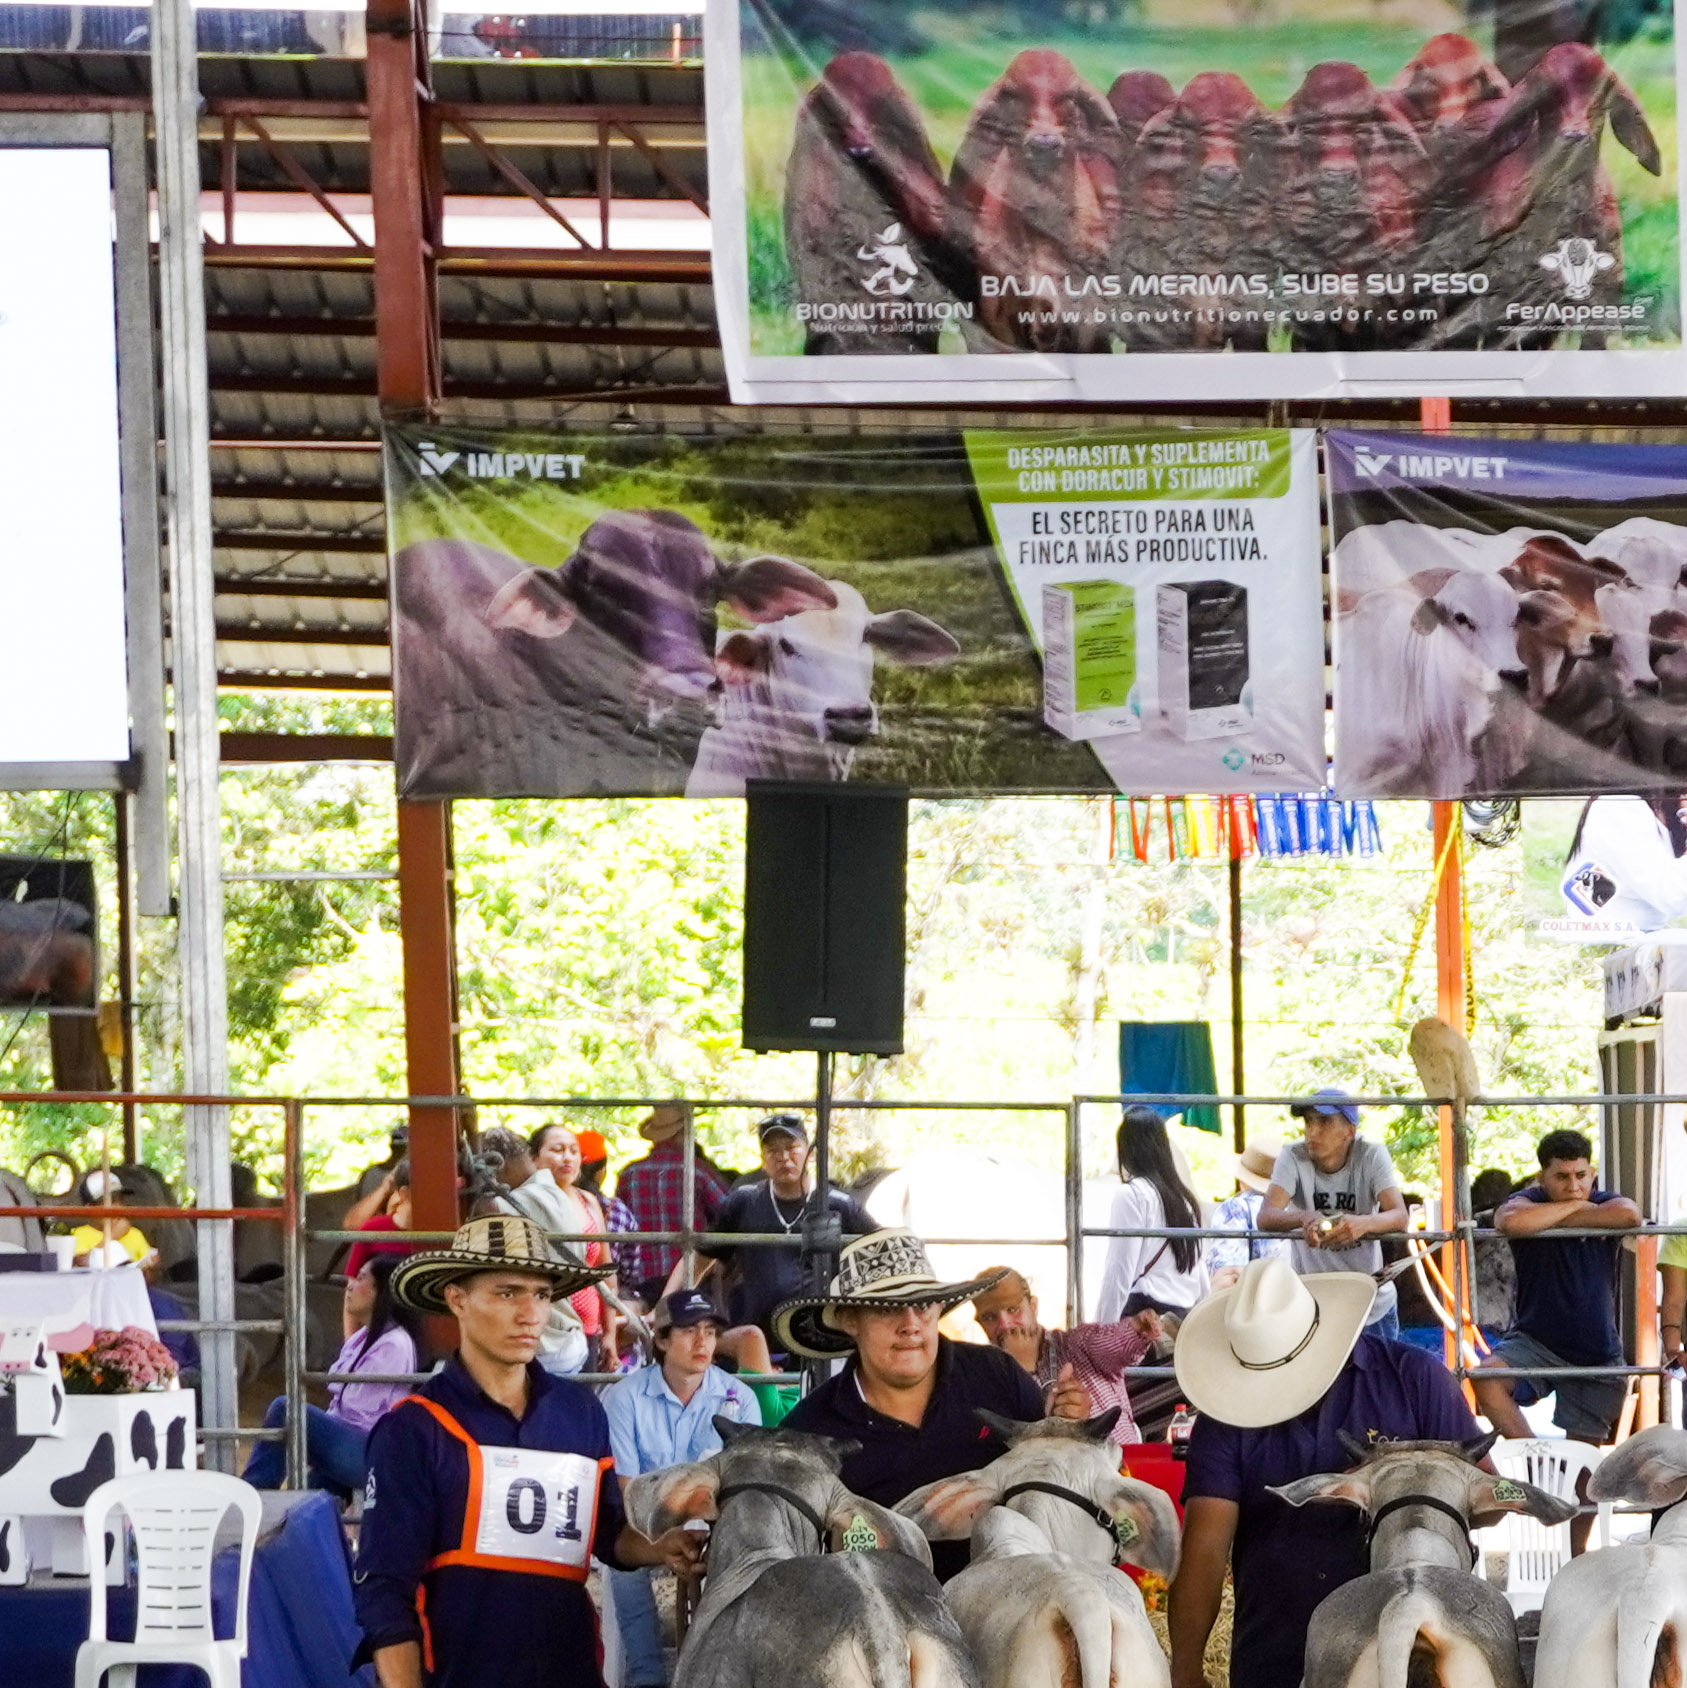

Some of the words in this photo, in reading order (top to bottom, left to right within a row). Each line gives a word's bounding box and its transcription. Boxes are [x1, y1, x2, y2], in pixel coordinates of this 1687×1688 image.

[981, 274, 1058, 297] BAJA
[1065, 274, 1122, 297] LAS
[1128, 273, 1276, 299] MERMAS,
[1282, 273, 1361, 296] SUBE
[1366, 273, 1407, 296] SU
[1412, 272, 1490, 295] PESO
[795, 301, 975, 322] BIONUTRITION
[1018, 305, 1439, 324] www.bionutritionecuador.com
[1505, 302, 1646, 323] FerAppease
[467, 453, 586, 479] IMPVET
[1008, 444, 1131, 469] DESPARASITA
[1134, 443, 1148, 464] Y
[1151, 439, 1271, 465] SUPLEMENTA
[1400, 454, 1509, 478] IMPVET
[1018, 471, 1057, 492] CON
[1061, 467, 1148, 492] DORACUR
[1150, 467, 1164, 490] Y
[1168, 465, 1260, 490] STIMOVIT:
[1032, 511, 1054, 535] EL
[1060, 509, 1148, 535] SECRETO
[1155, 508, 1207, 533] PARA
[1213, 507, 1255, 532] UNA
[1019, 540, 1079, 565] FINCA
[1086, 534, 1129, 564] MÁS
[1136, 536, 1268, 563] PRODUCTIVA.
[1251, 752, 1286, 766] MSD
[1542, 921, 1612, 932] COLETMAX
[506, 1476, 583, 1542] 01
